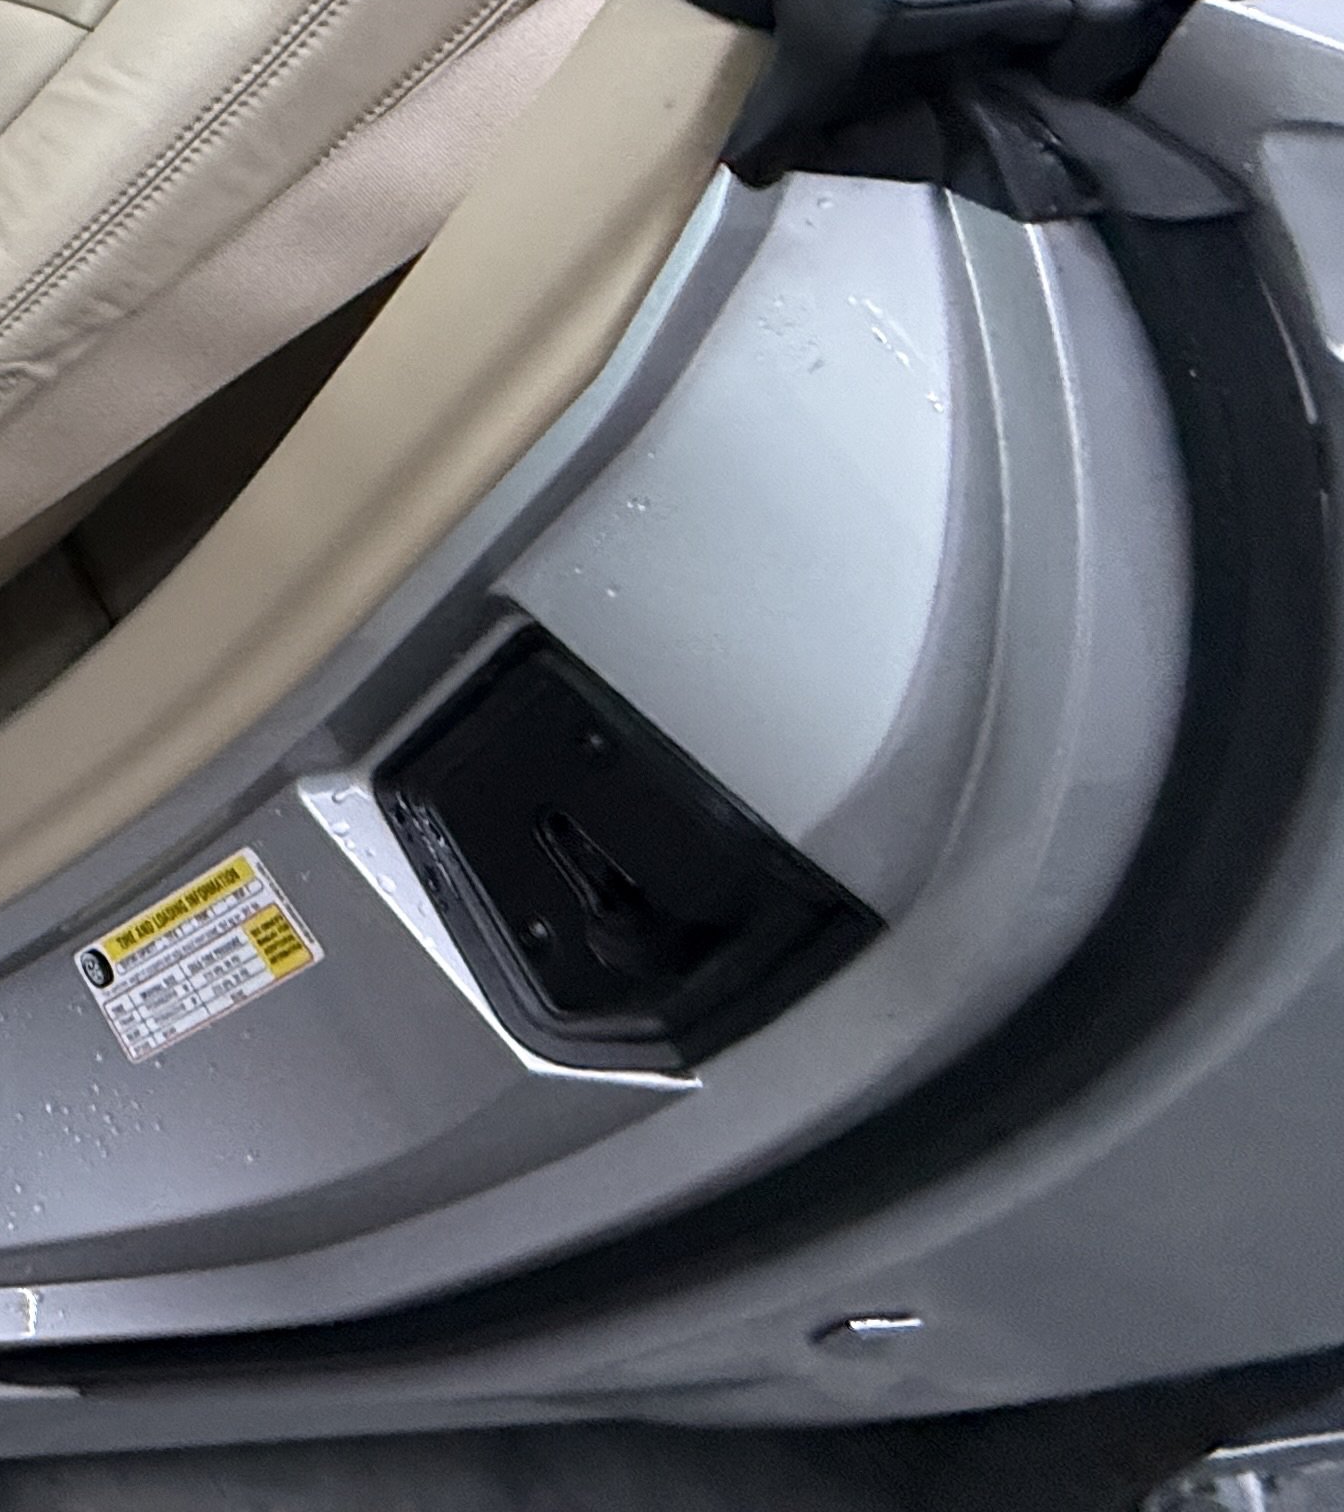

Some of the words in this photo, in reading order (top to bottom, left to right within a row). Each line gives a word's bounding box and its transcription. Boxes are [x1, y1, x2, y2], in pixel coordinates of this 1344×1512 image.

[135, 920, 154, 939] AND
[152, 899, 188, 928] LOADING
[184, 868, 240, 906] INFORMATION
